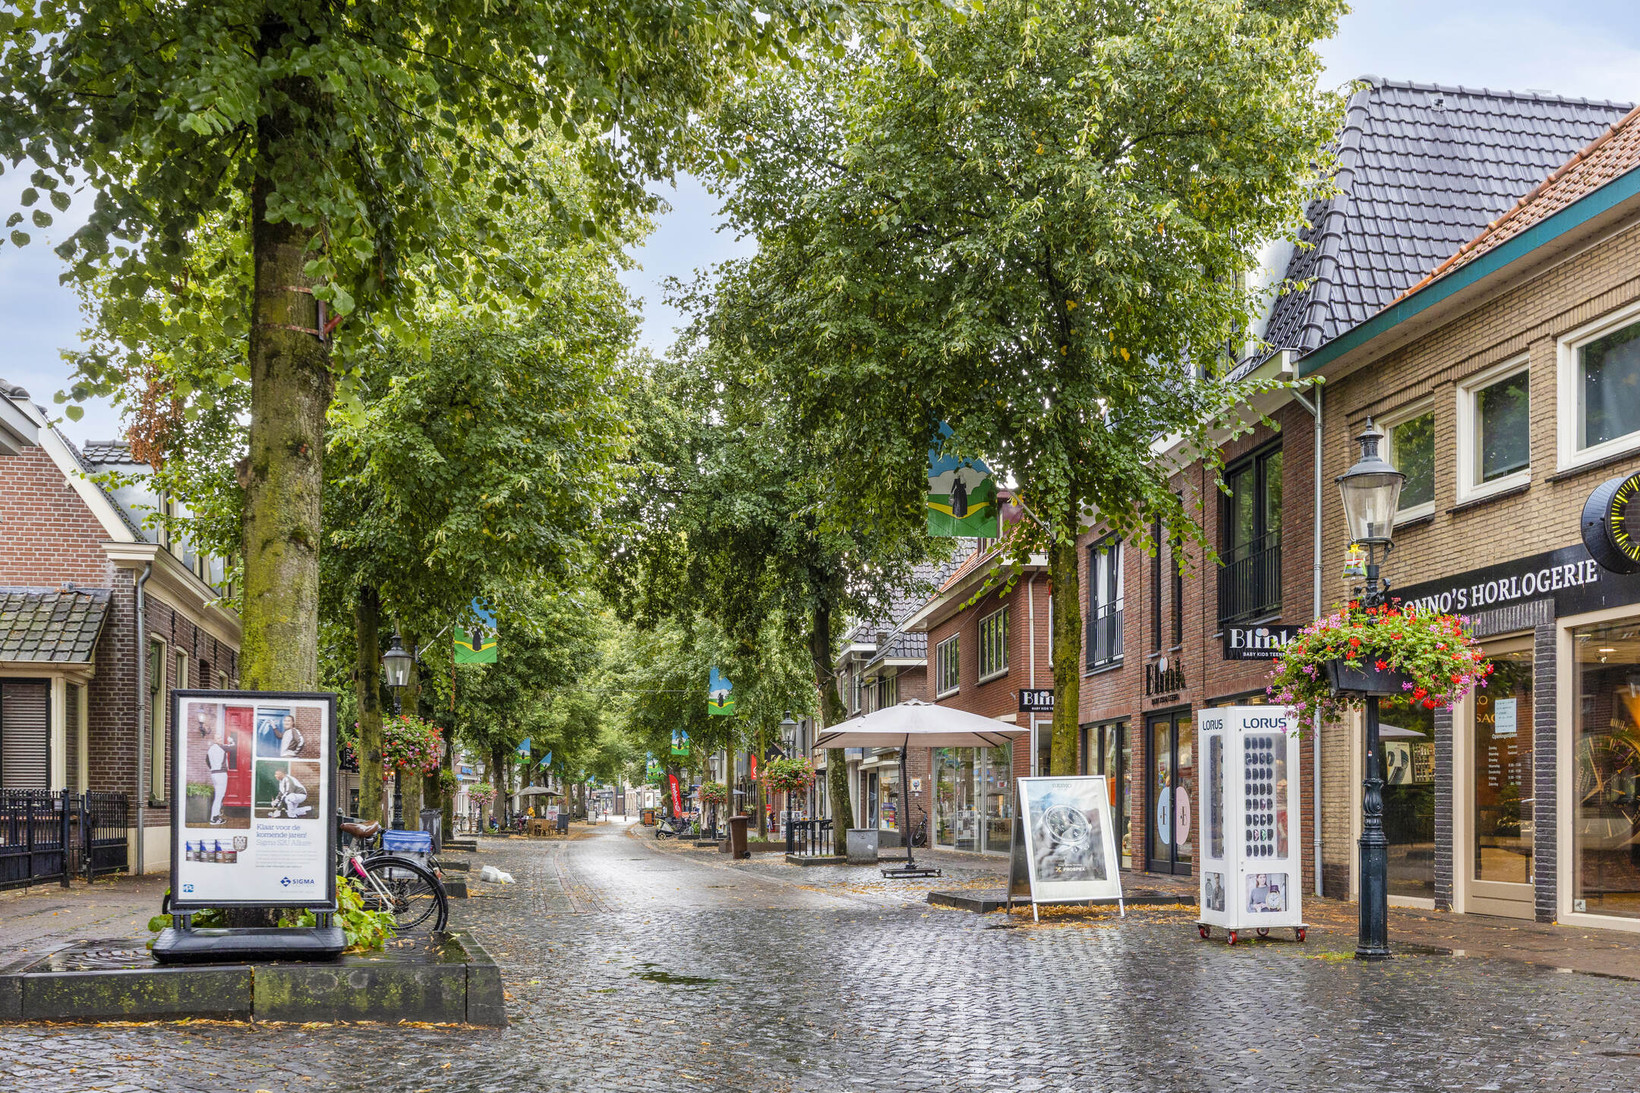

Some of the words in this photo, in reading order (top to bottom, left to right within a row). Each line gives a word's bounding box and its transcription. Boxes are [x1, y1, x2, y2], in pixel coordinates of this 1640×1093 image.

[1403, 588, 1468, 620] ONNO'S
[1471, 559, 1598, 607] HORLOGERIE
[1229, 627, 1297, 649] Blink
[1145, 656, 1187, 696] Blink
[1022, 691, 1055, 705] Blin
[1202, 719, 1224, 731] LORUS
[1243, 718, 1287, 729] LORUS
[256, 823, 275, 831] Klaar
